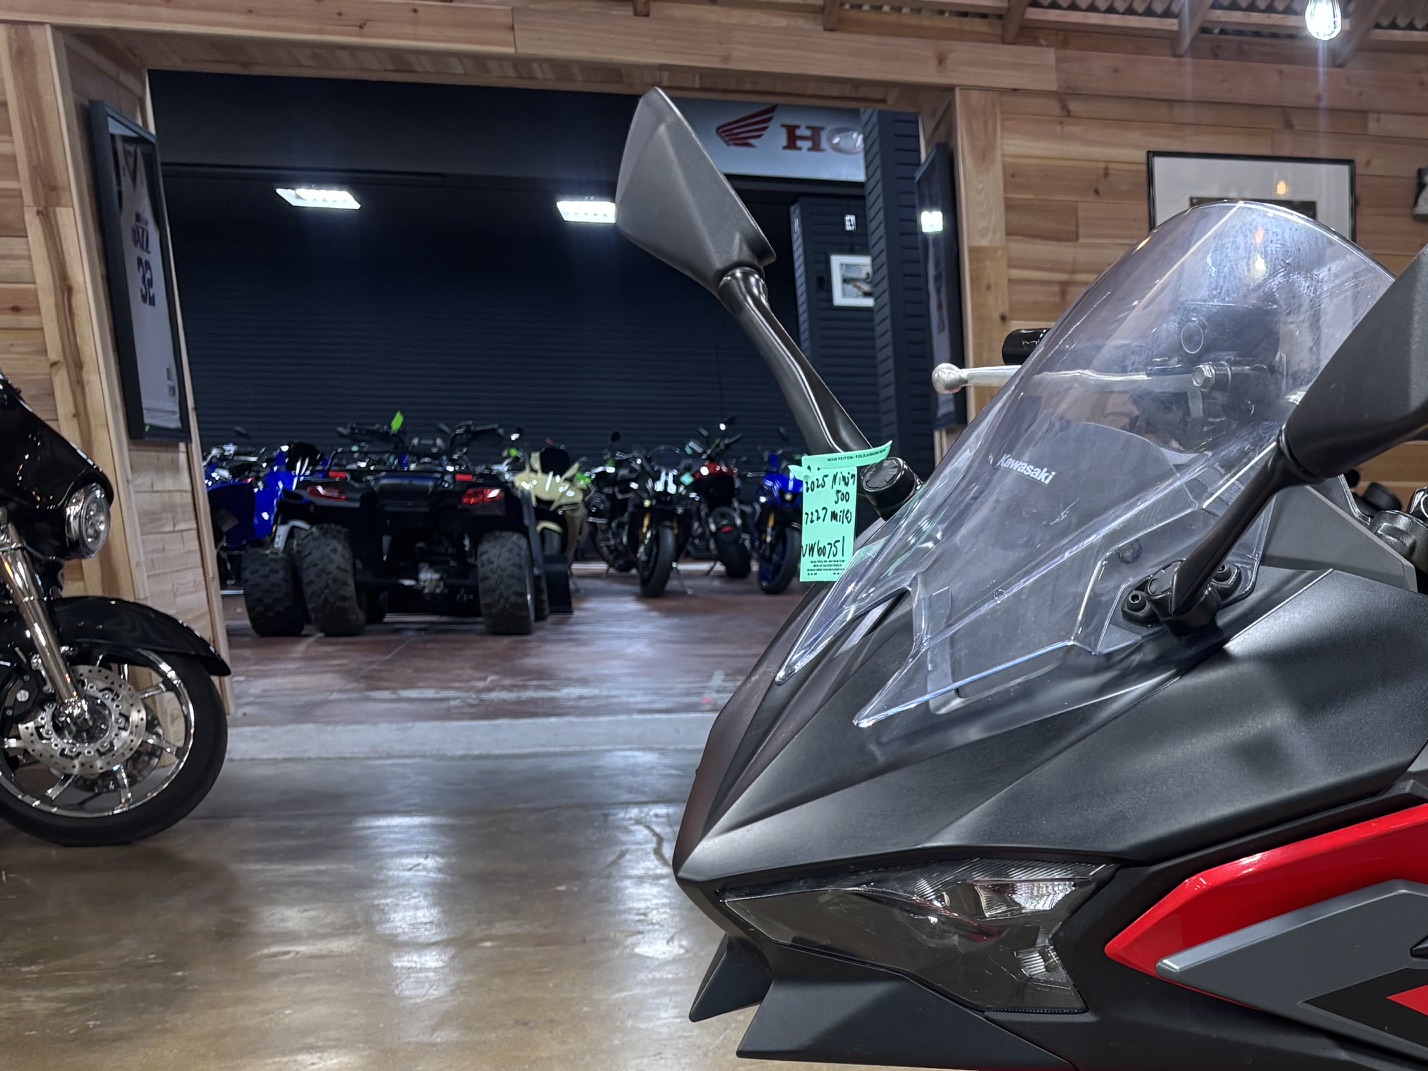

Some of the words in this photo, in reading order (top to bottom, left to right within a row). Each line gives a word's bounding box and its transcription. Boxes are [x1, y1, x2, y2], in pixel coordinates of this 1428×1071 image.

[136, 256, 156, 307] 32
[995, 453, 1056, 484] Kawasaki
[805, 474, 829, 493] 2025
[834, 489, 850, 505] 500
[804, 506, 828, 526] 7227
